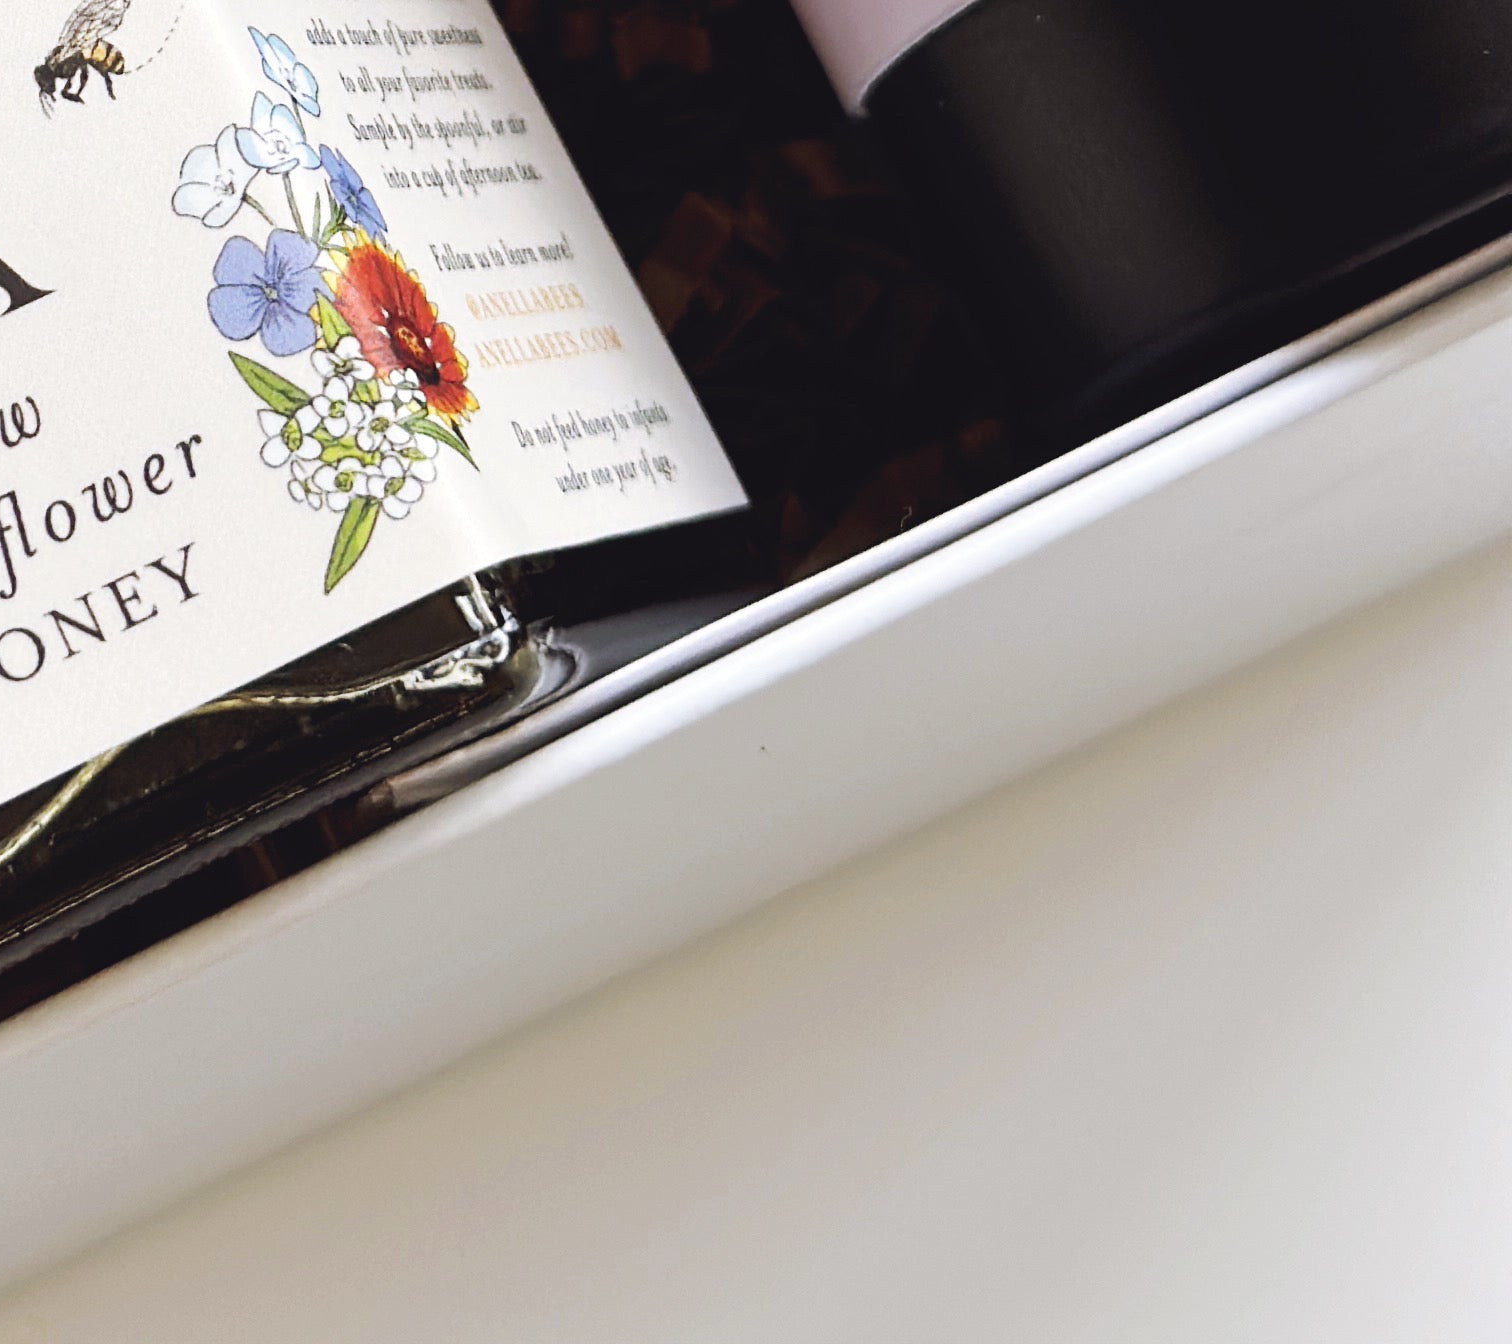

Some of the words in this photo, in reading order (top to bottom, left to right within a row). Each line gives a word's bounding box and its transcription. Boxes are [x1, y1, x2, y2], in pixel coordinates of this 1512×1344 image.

[305, 18, 337, 46] adds
[344, 18, 382, 46] touch
[383, 18, 402, 56] of
[338, 68, 357, 93] to
[356, 65, 376, 93] all
[346, 112, 398, 151] Sample
[391, 112, 414, 150] by
[409, 112, 435, 140] the
[380, 163, 412, 189] into
[422, 164, 448, 198] cup
[444, 157, 464, 198] of
[429, 242, 476, 273] Follow
[473, 252, 491, 270] us
[488, 244, 506, 268] to
[498, 238, 539, 265] learn
[510, 419, 536, 449] Do
[536, 422, 559, 446] not
[551, 409, 583, 453] feed
[554, 462, 591, 494] under
[590, 467, 614, 486] one
